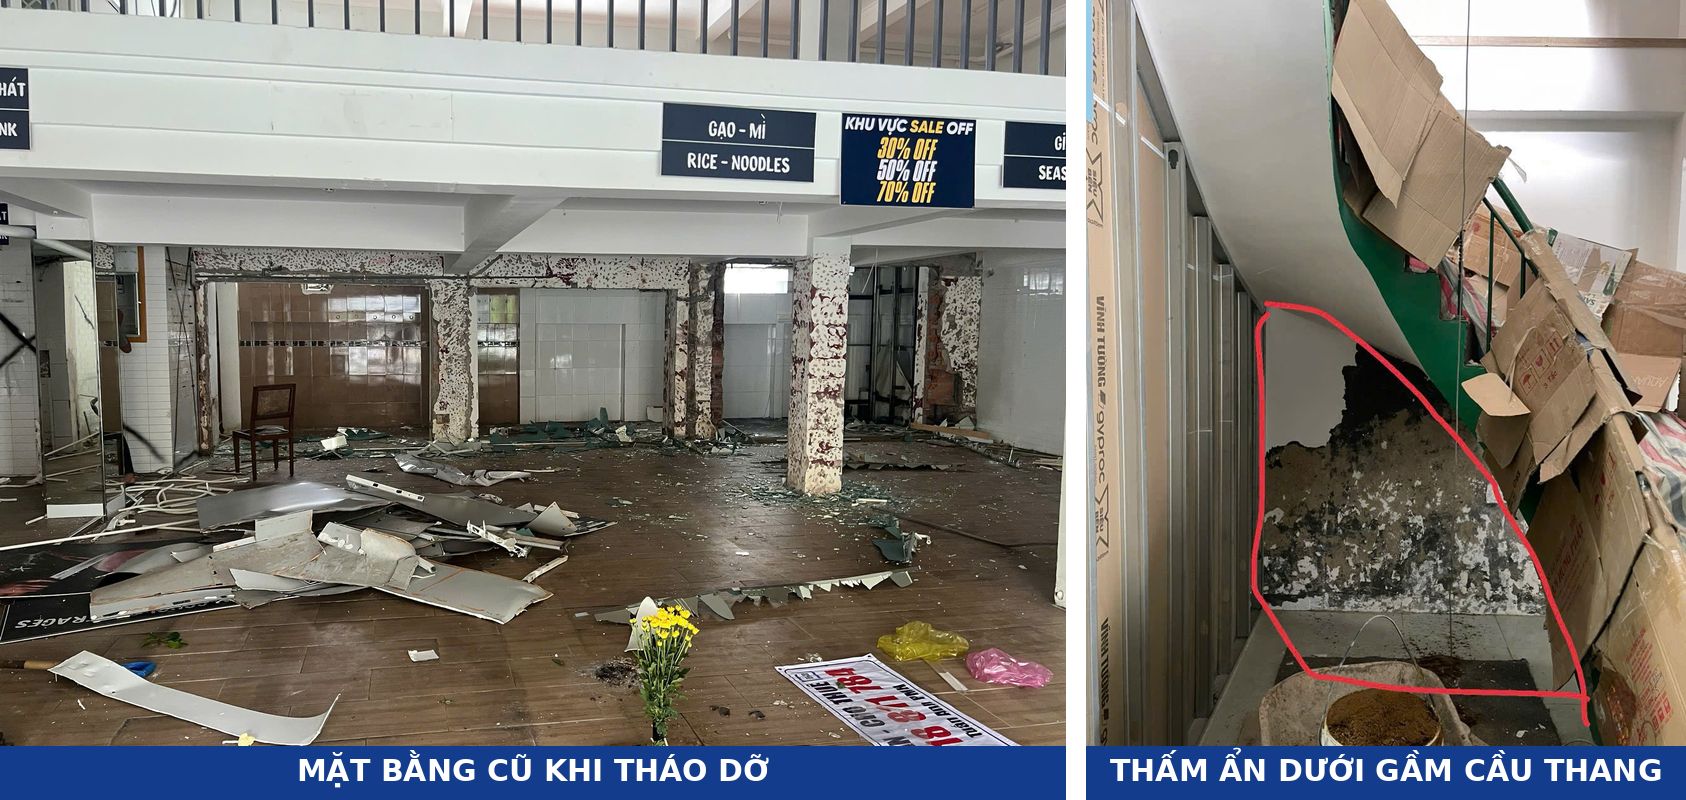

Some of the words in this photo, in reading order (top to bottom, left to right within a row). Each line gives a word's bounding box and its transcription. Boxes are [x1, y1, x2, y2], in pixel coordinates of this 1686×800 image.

[708, 120, 736, 140] GẠO
[845, 116, 876, 131] KHU
[878, 118, 909, 136] VỰC
[910, 119, 945, 134] SALE
[946, 121, 974, 136] OFF
[877, 136, 911, 160] 30%
[913, 138, 938, 161] OFF
[687, 152, 718, 170] RICE
[731, 154, 790, 173] NOODLES
[876, 158, 911, 182] 50%
[912, 160, 938, 183] OFF
[876, 180, 910, 204] 70%
[911, 182, 937, 205] OFF
[1096, 410, 1105, 484] gyproc
[15, 615, 92, 629] RAGES
